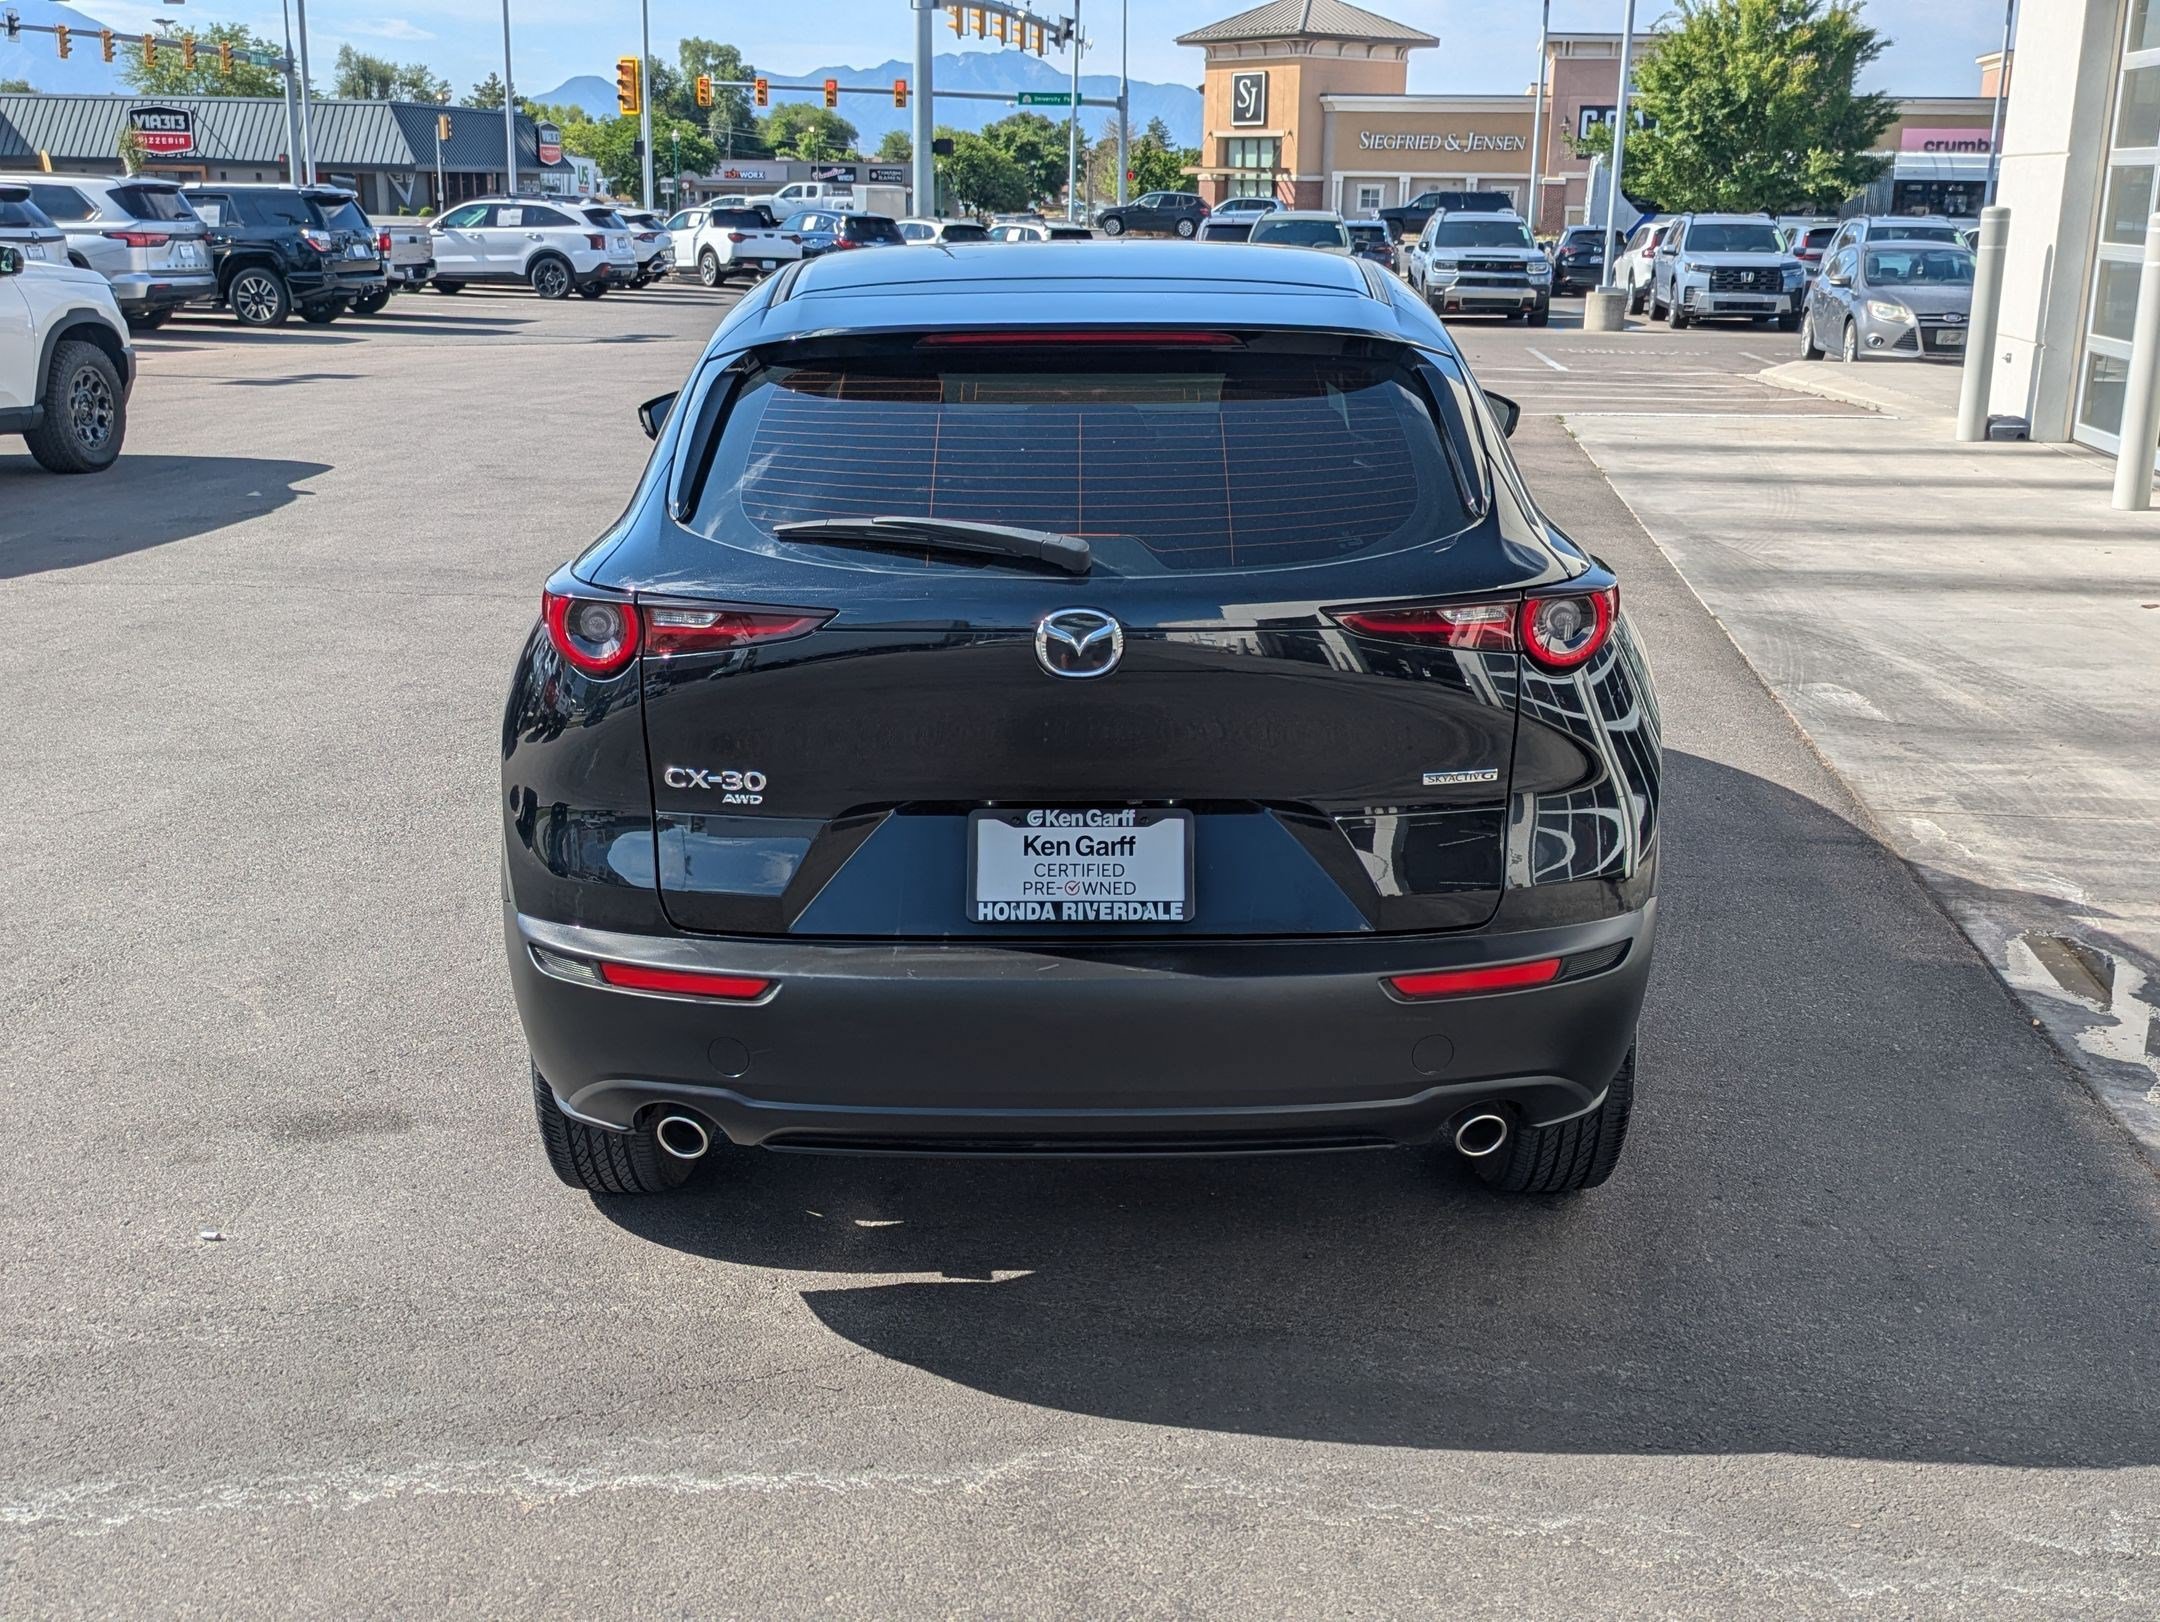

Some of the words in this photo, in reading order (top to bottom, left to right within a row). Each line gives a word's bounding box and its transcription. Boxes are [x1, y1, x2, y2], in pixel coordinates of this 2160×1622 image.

[1359, 131, 1441, 150] SIEGFRIED
[1444, 133, 1461, 151] &
[1463, 132, 1526, 152] JENSEN
[1923, 138, 1990, 152] crumb
[664, 767, 767, 792] CX-30
[722, 793, 763, 805] AWD
[1045, 809, 1084, 827] Ken
[1086, 809, 1135, 827] Garff
[1023, 835, 1070, 856] Ken
[1075, 835, 1136, 856] Garff
[1034, 863, 1125, 878] CERTIFIED
[978, 902, 1055, 921] HONDA
[1062, 902, 1184, 921] RIVERDALE
